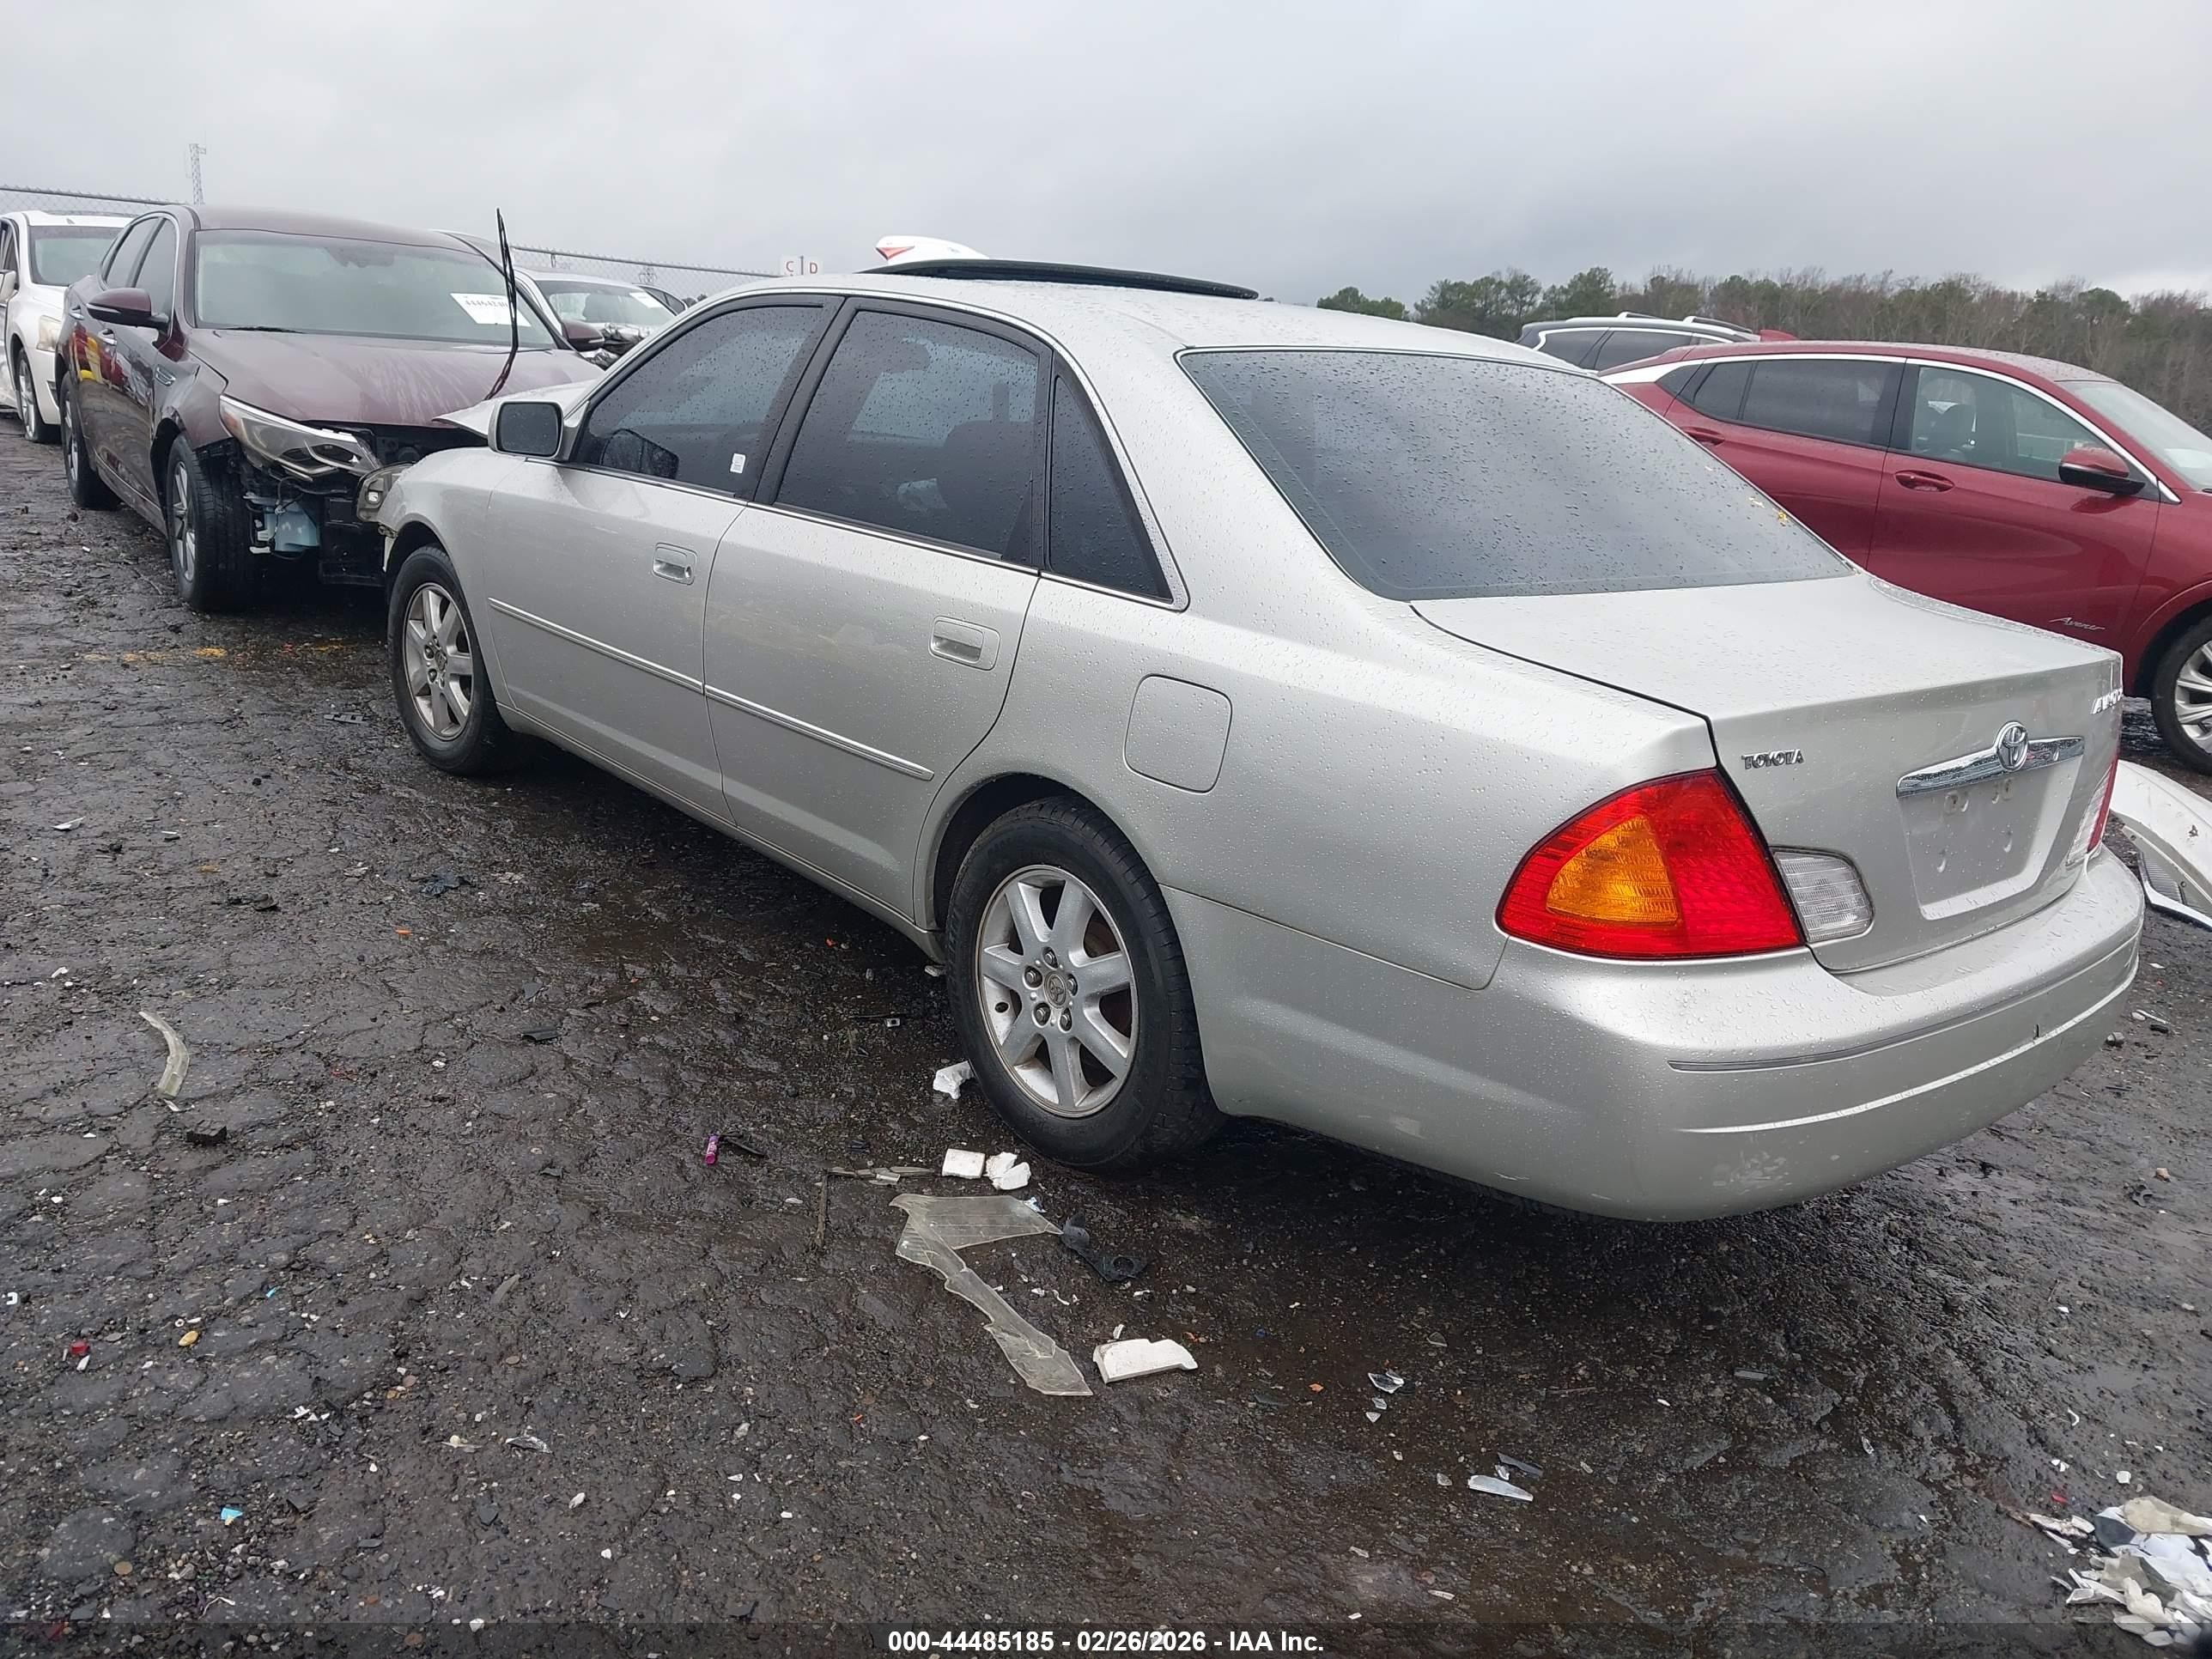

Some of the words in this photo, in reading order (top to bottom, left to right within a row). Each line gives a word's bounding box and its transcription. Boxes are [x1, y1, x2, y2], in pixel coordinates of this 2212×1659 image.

[786, 260, 794, 273] C
[809, 262, 818, 275] D
[1741, 749, 1805, 770] TOYOTA
